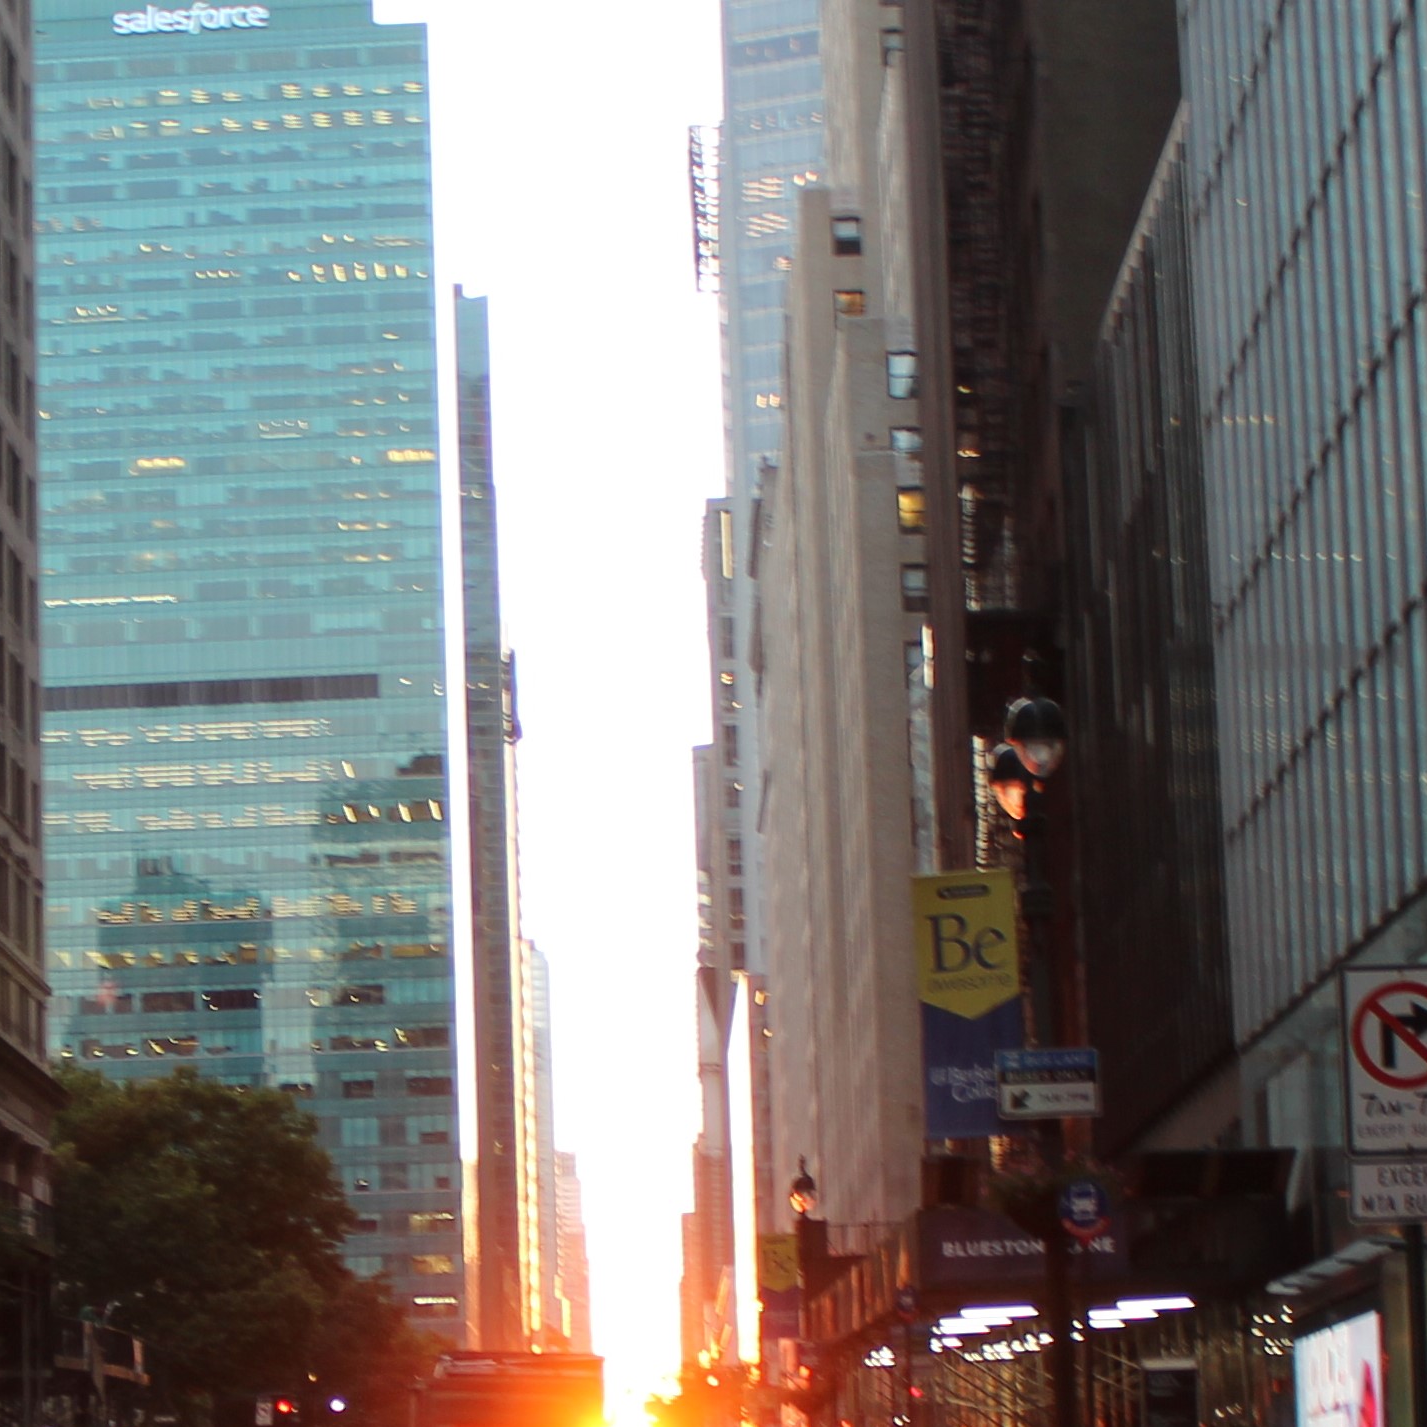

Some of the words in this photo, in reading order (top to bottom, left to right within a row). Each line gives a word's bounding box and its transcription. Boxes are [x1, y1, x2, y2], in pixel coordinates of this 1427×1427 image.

[113, 1, 270, 35] salesforce
[925, 913, 1007, 973] Be
[941, 1238, 1045, 1258] BLUESTON
